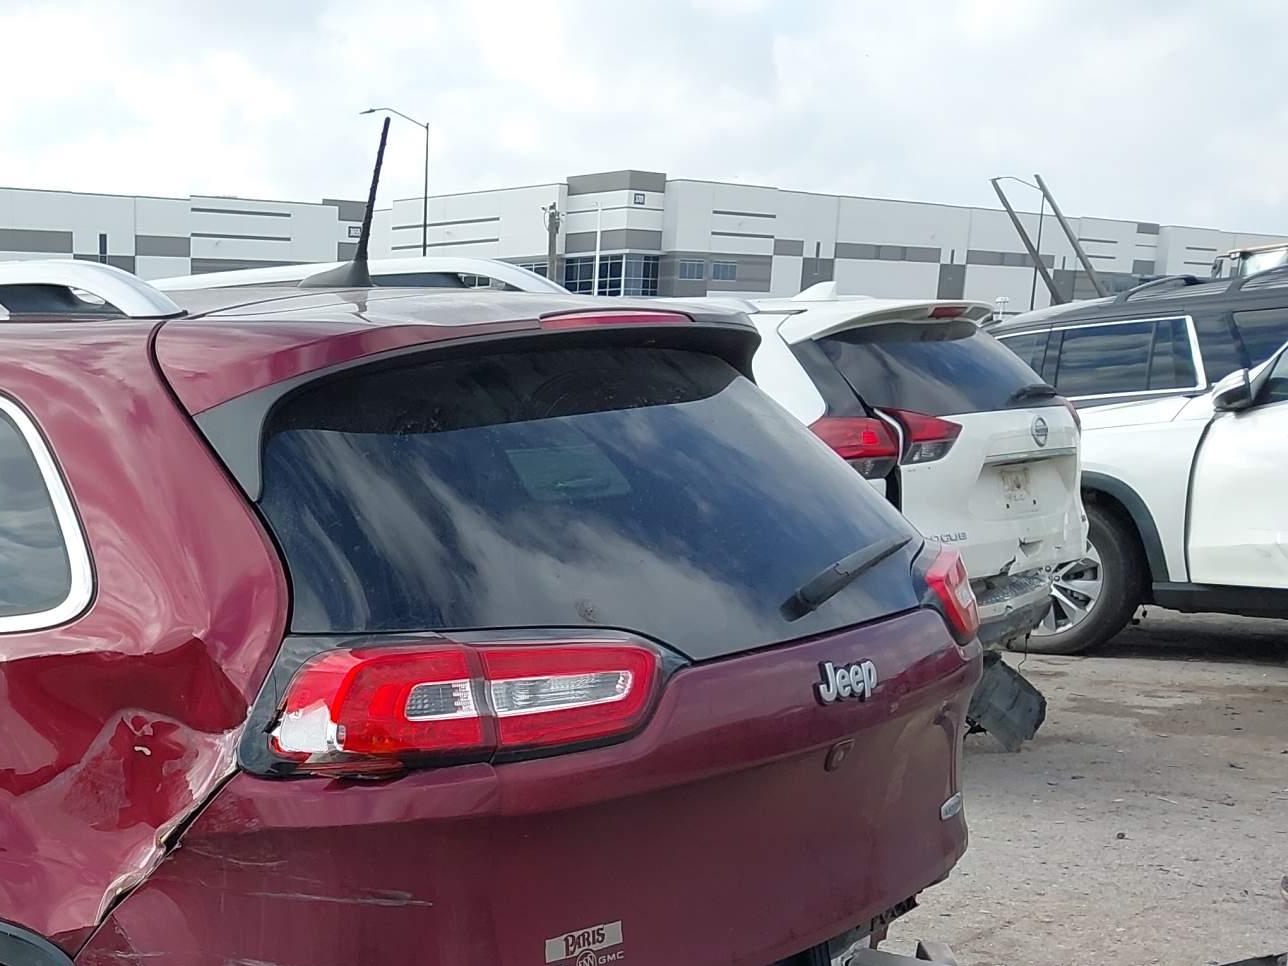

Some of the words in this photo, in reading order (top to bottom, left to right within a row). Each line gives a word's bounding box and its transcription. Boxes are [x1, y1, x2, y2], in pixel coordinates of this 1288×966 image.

[816, 659, 877, 703] Jeep
[563, 926, 606, 956] PARIS
[598, 951, 625, 965] GMC
